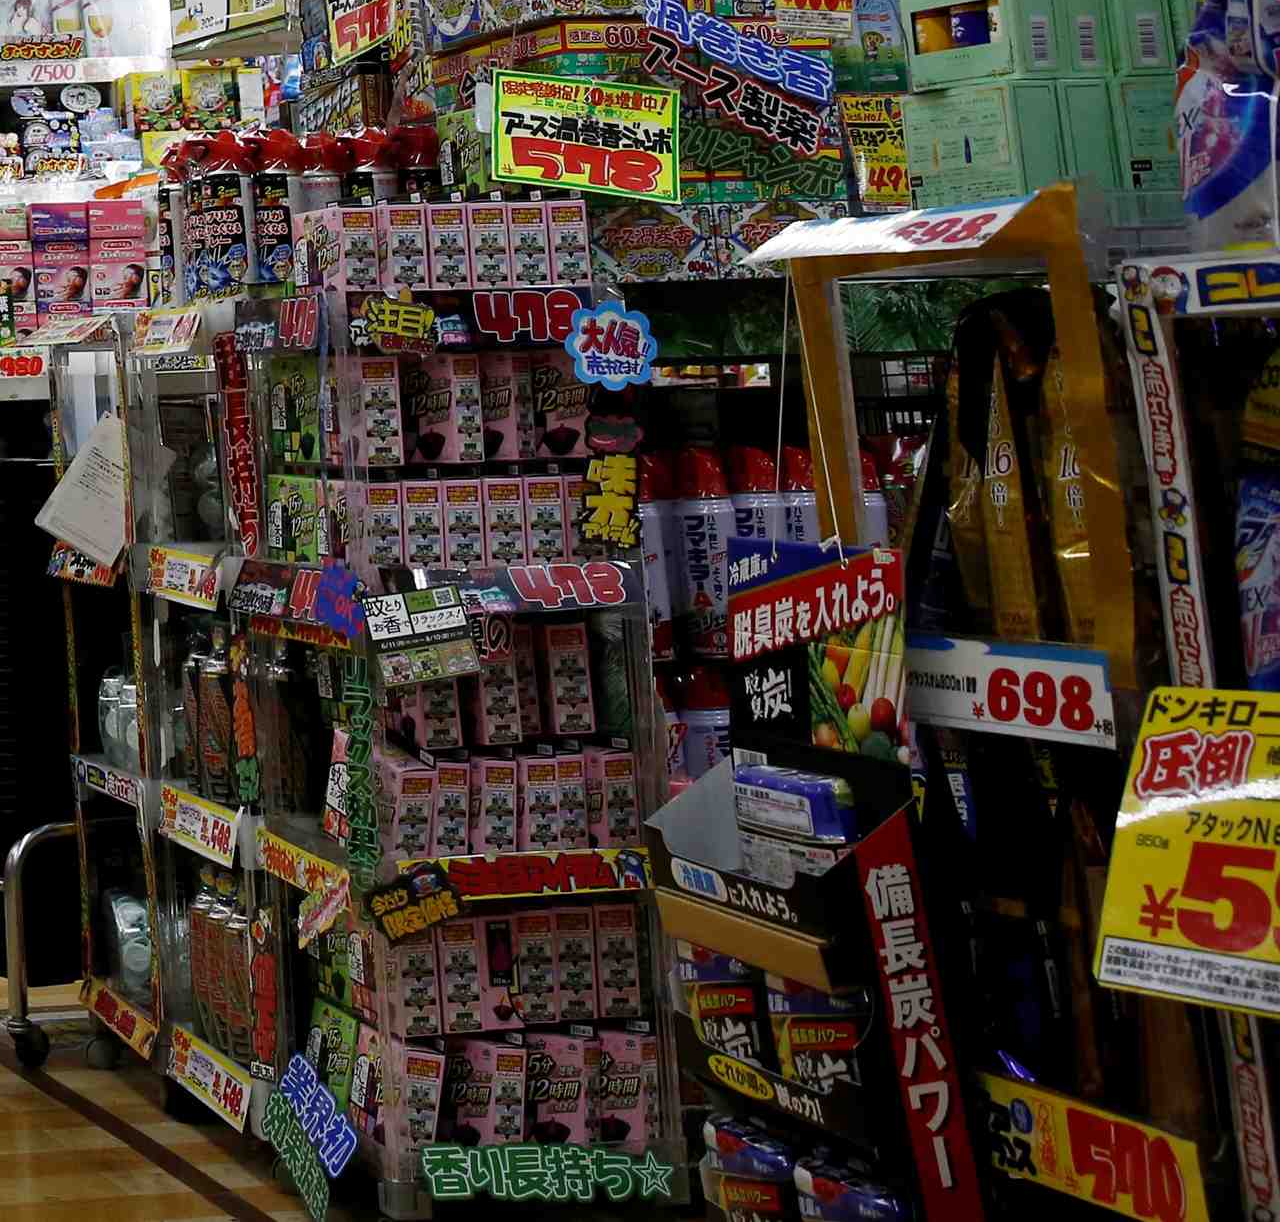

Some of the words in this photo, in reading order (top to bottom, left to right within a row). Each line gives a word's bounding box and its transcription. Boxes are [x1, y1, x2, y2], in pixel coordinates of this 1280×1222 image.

[642, 29, 821, 155] アース製薬
[510, 135, 664, 193] 578
[472, 289, 583, 342] 478
[0, 355, 44, 377] 980
[506, 560, 627, 609] 478
[411, 609, 461, 626] リラックス!
[733, 566, 896, 659] 脱臭炭を入れよう。
[972, 701, 986, 722] ¥
[986, 668, 1096, 733] 698
[1095, 716, 1114, 738] +税
[1136, 729, 1255, 799] 圧倒
[727, 883, 800, 926] に入れよう。
[1138, 883, 1179, 938] ¥
[863, 862, 959, 1191] 備長炭パワー
[527, 1078, 579, 1101] 12時間
[422, 1145, 633, 1199] 香り長持ち
